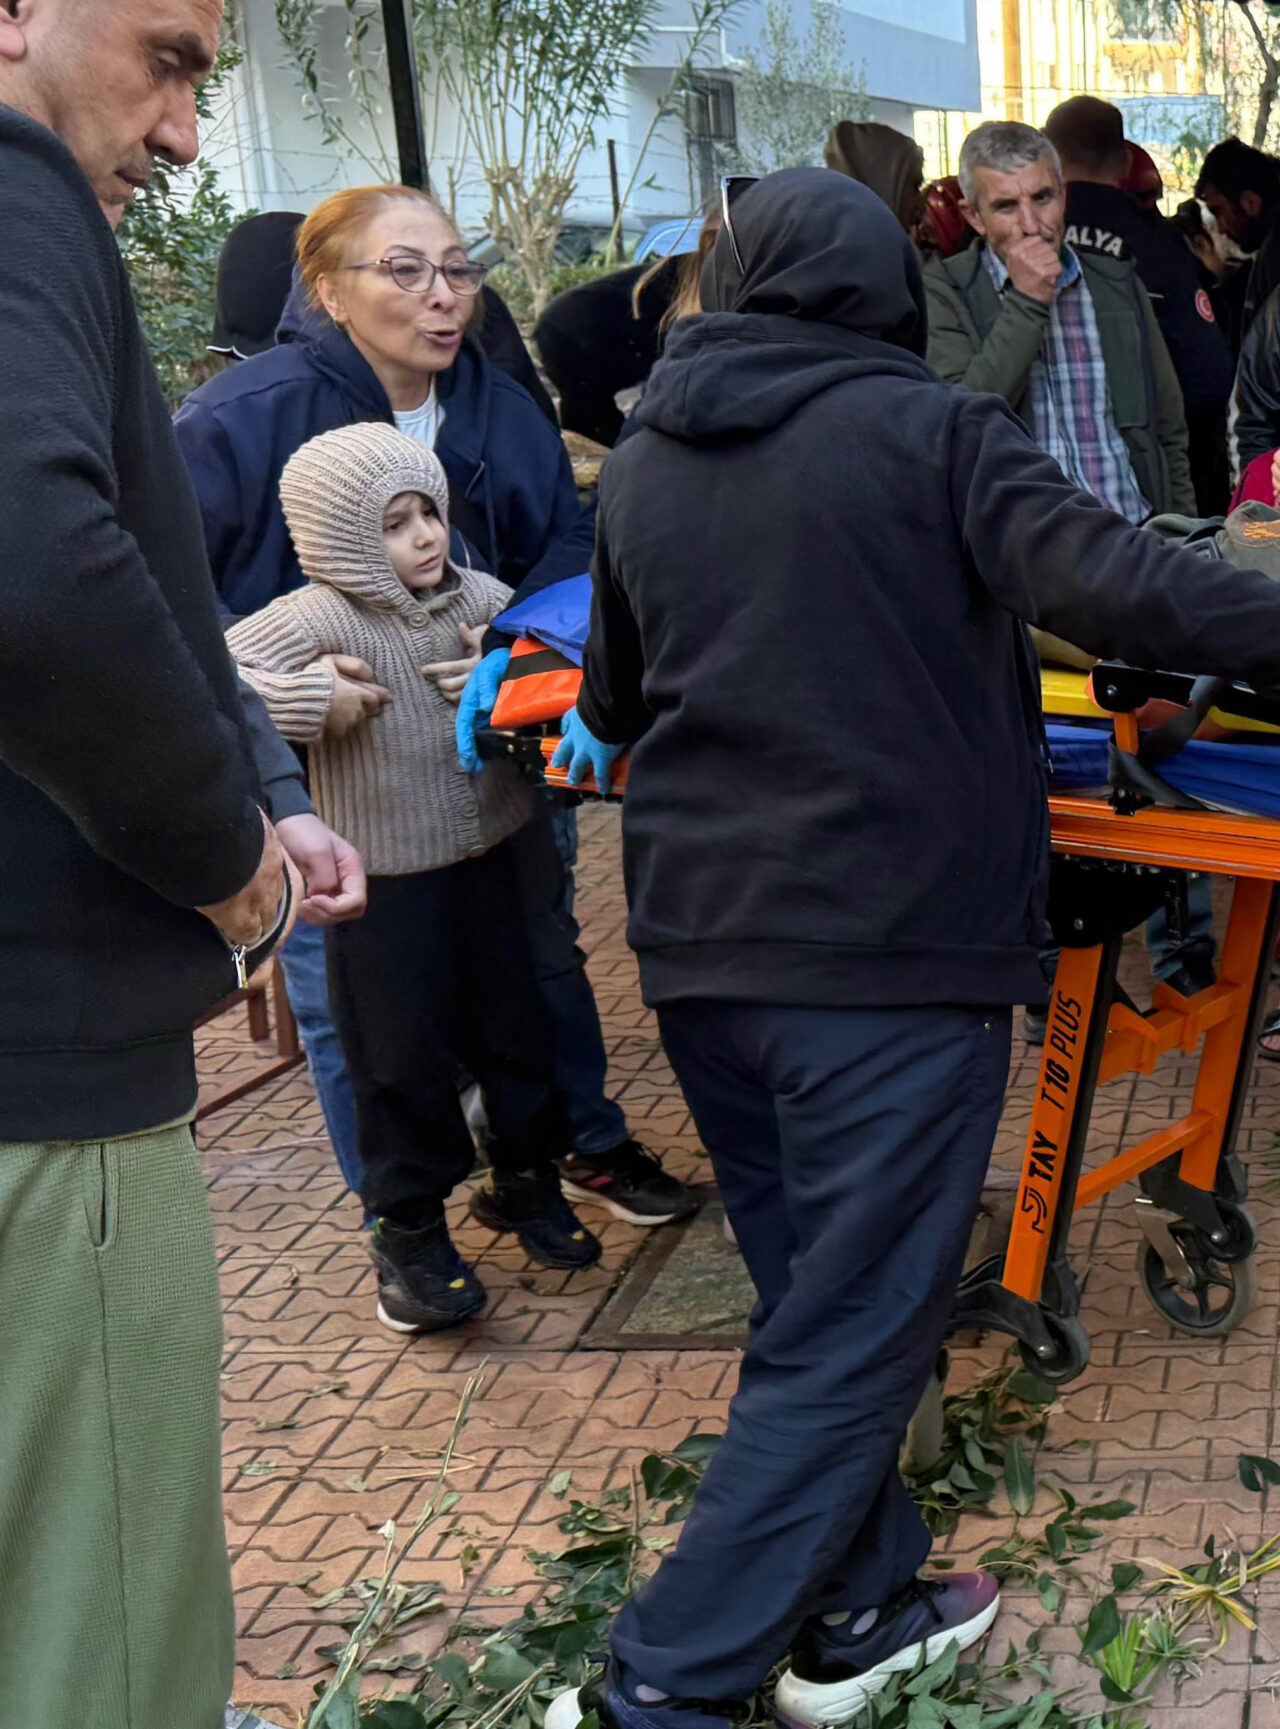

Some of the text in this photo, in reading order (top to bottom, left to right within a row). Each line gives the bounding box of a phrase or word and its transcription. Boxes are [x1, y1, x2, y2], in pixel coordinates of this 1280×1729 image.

[1064, 225, 1123, 257] ALYA
[1028, 1130, 1059, 1182] TAY
[1050, 990, 1083, 1061] PLUS
